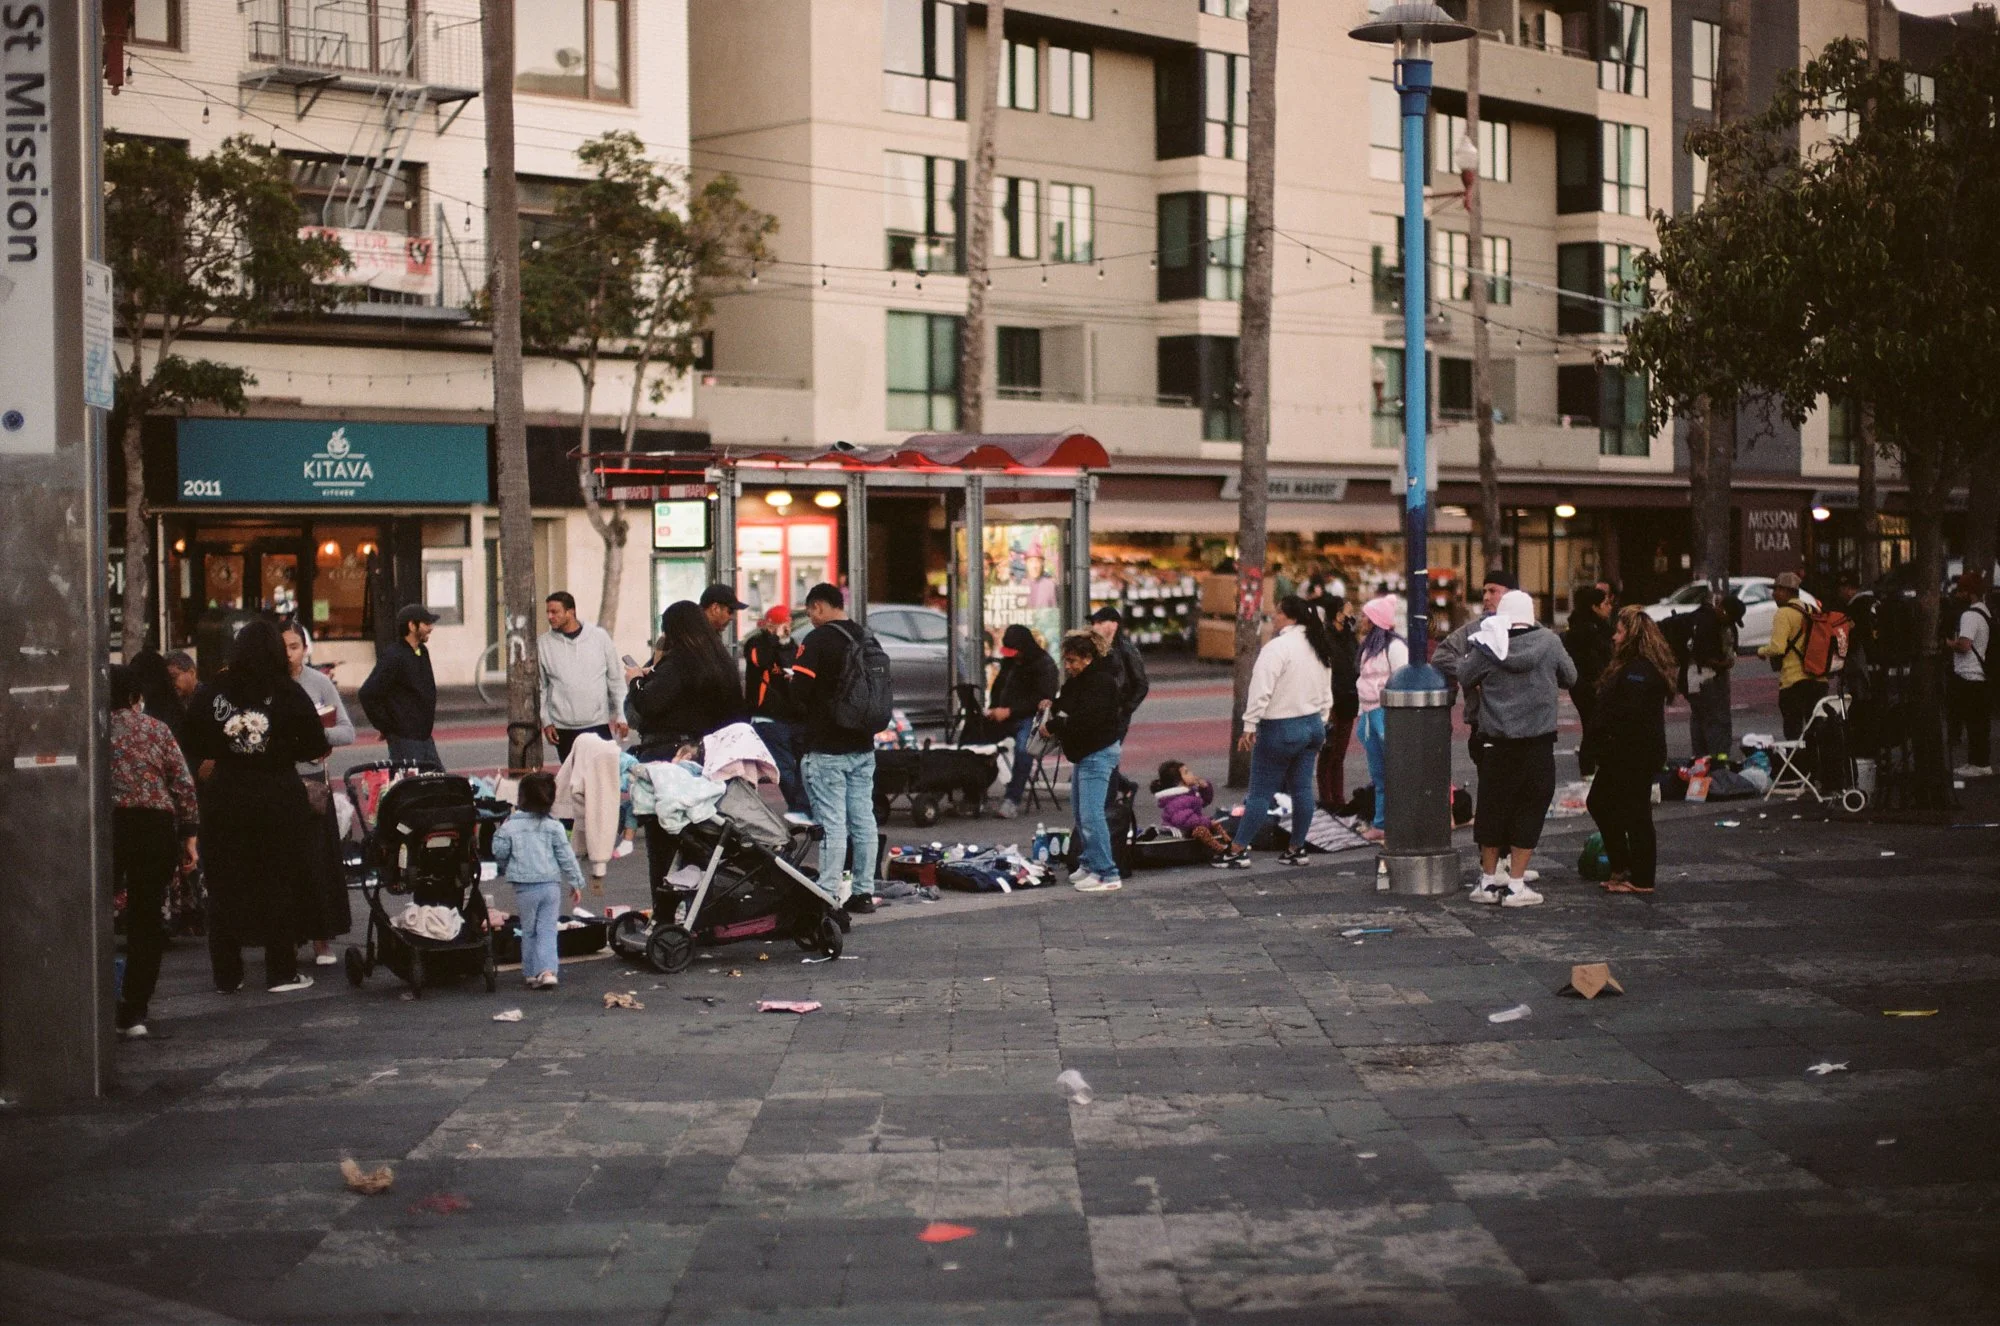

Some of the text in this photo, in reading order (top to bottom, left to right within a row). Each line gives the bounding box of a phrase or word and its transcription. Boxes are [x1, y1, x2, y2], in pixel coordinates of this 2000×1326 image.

[2, 3, 49, 263] St Mission
[303, 460, 374, 480] KITAVA
[183, 479, 222, 496] 2011
[1748, 510, 1798, 530] MISSION
[1754, 531, 1791, 551] PLAZA
